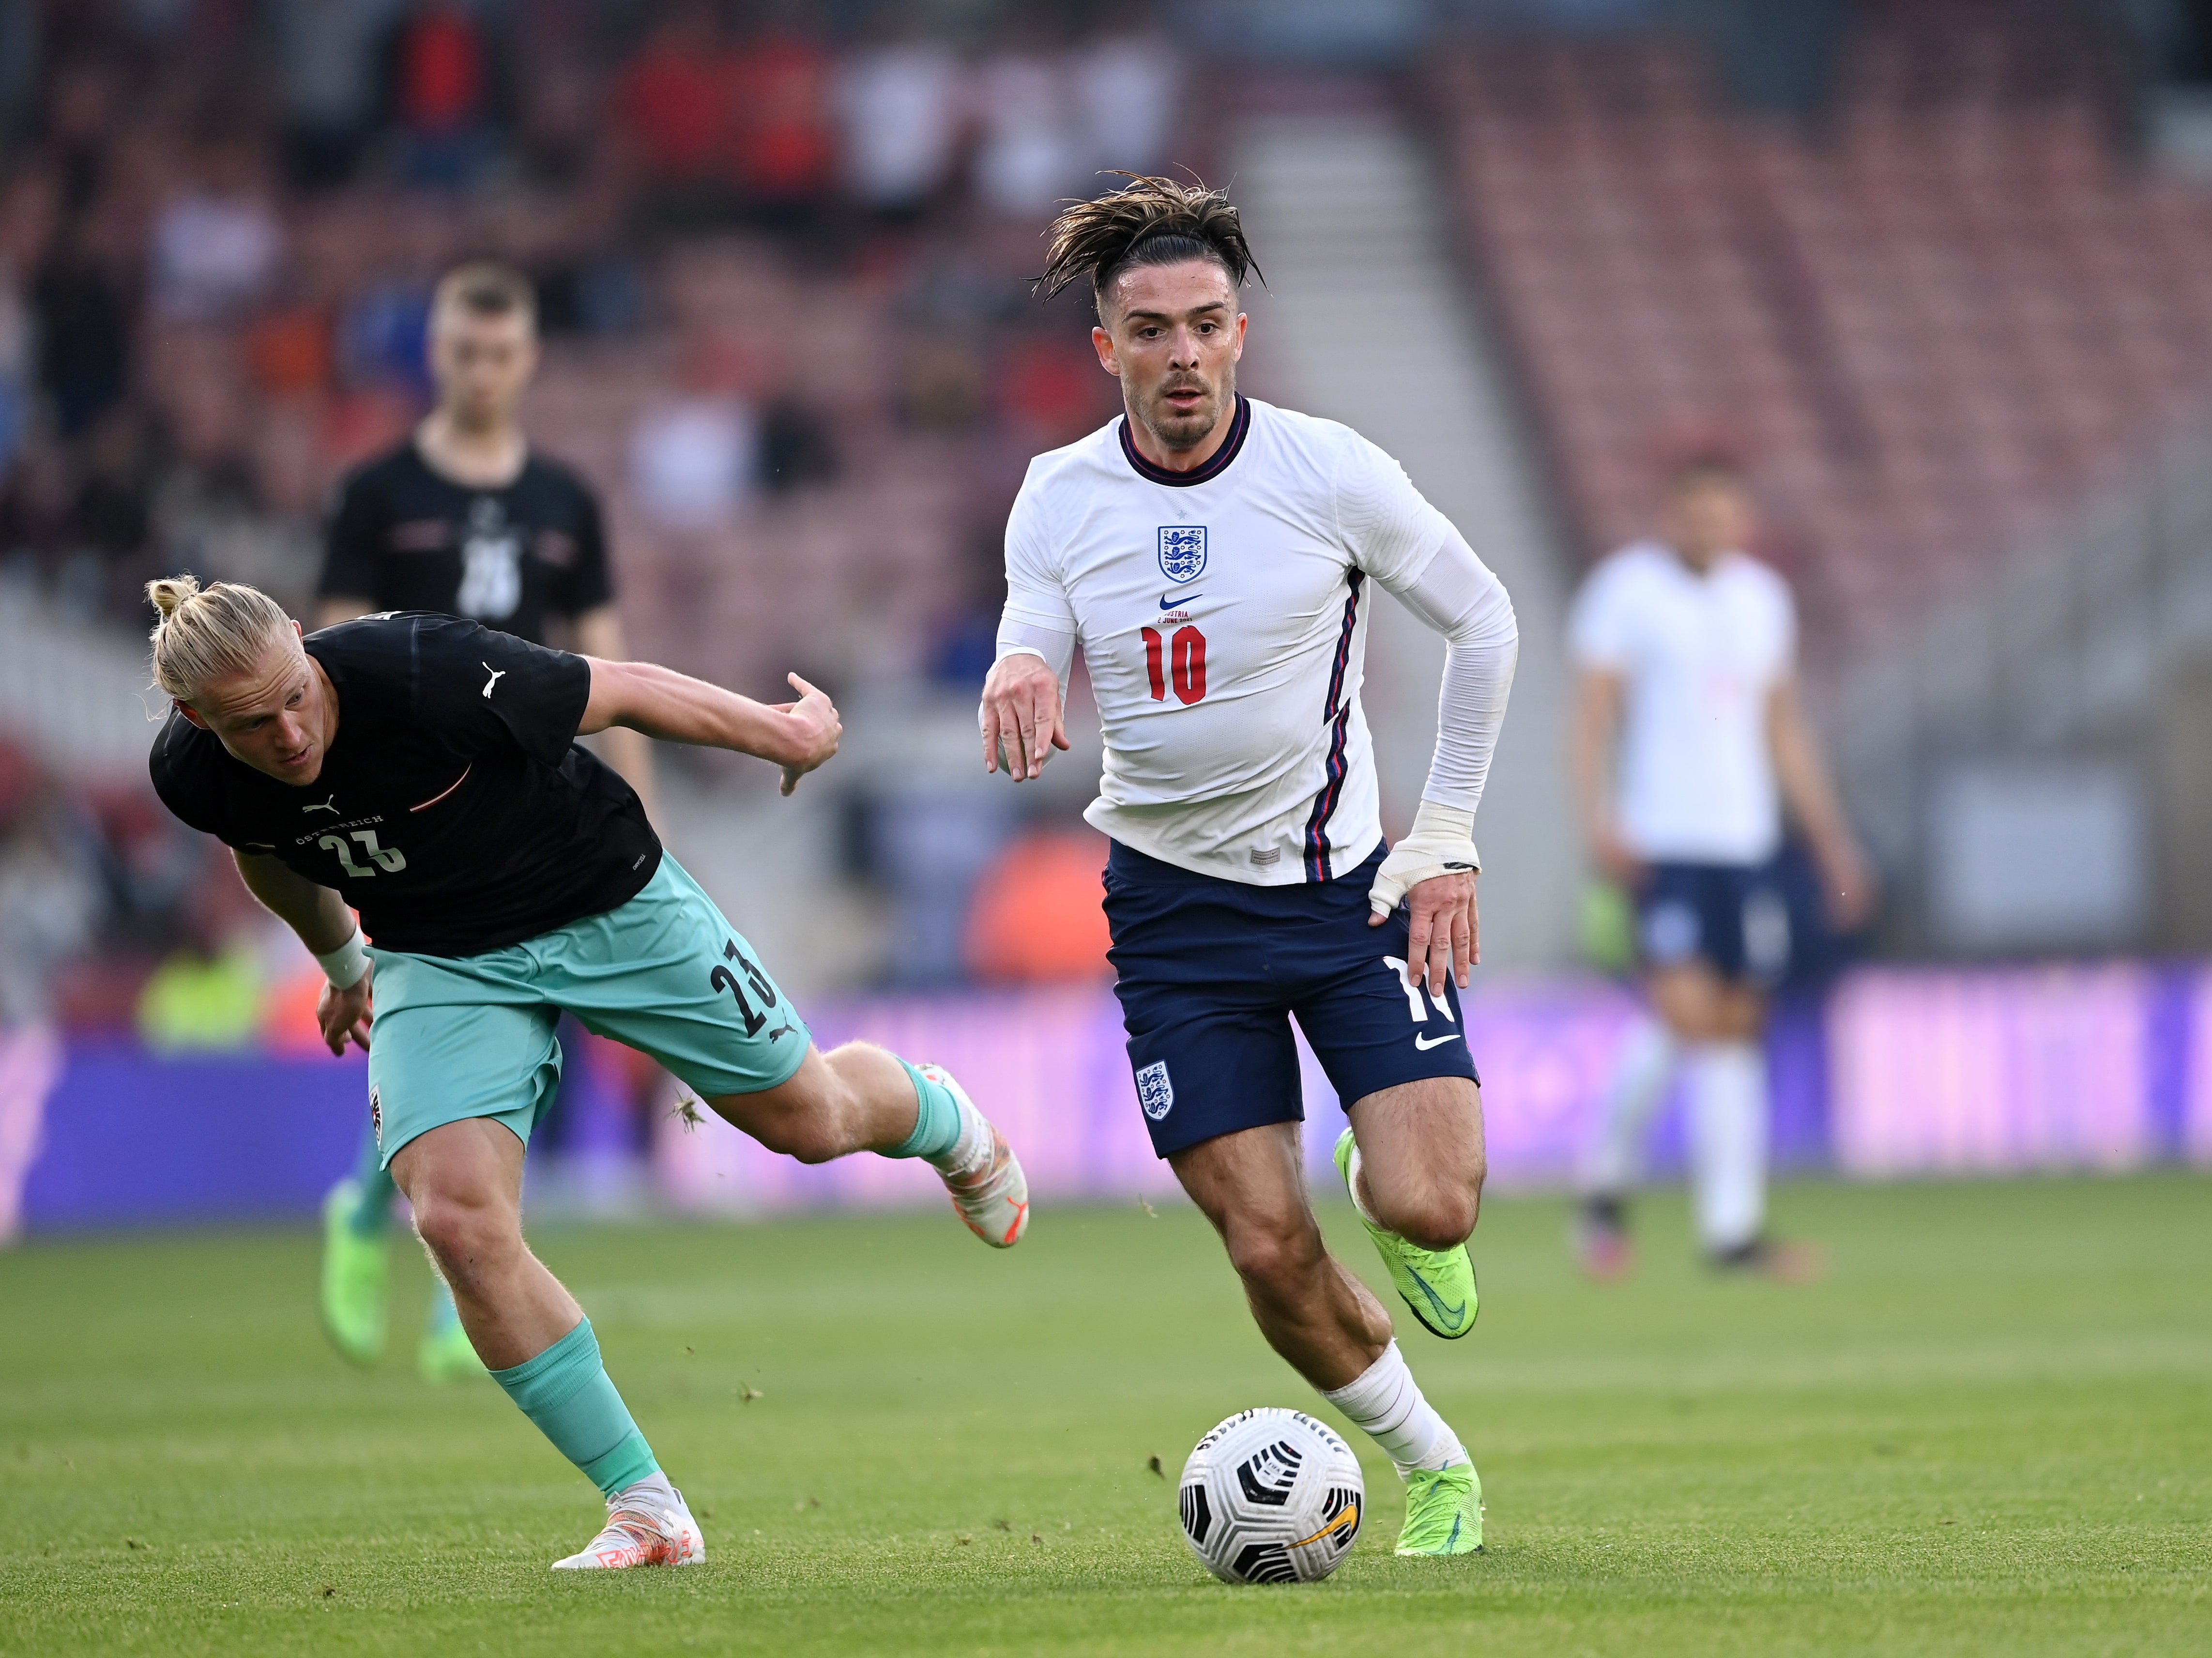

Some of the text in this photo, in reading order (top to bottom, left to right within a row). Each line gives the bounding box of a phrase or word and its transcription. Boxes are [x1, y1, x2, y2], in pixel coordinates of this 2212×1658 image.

[1141, 625, 1206, 706] 10
[318, 829, 407, 877] 23
[710, 937, 777, 1039] 23
